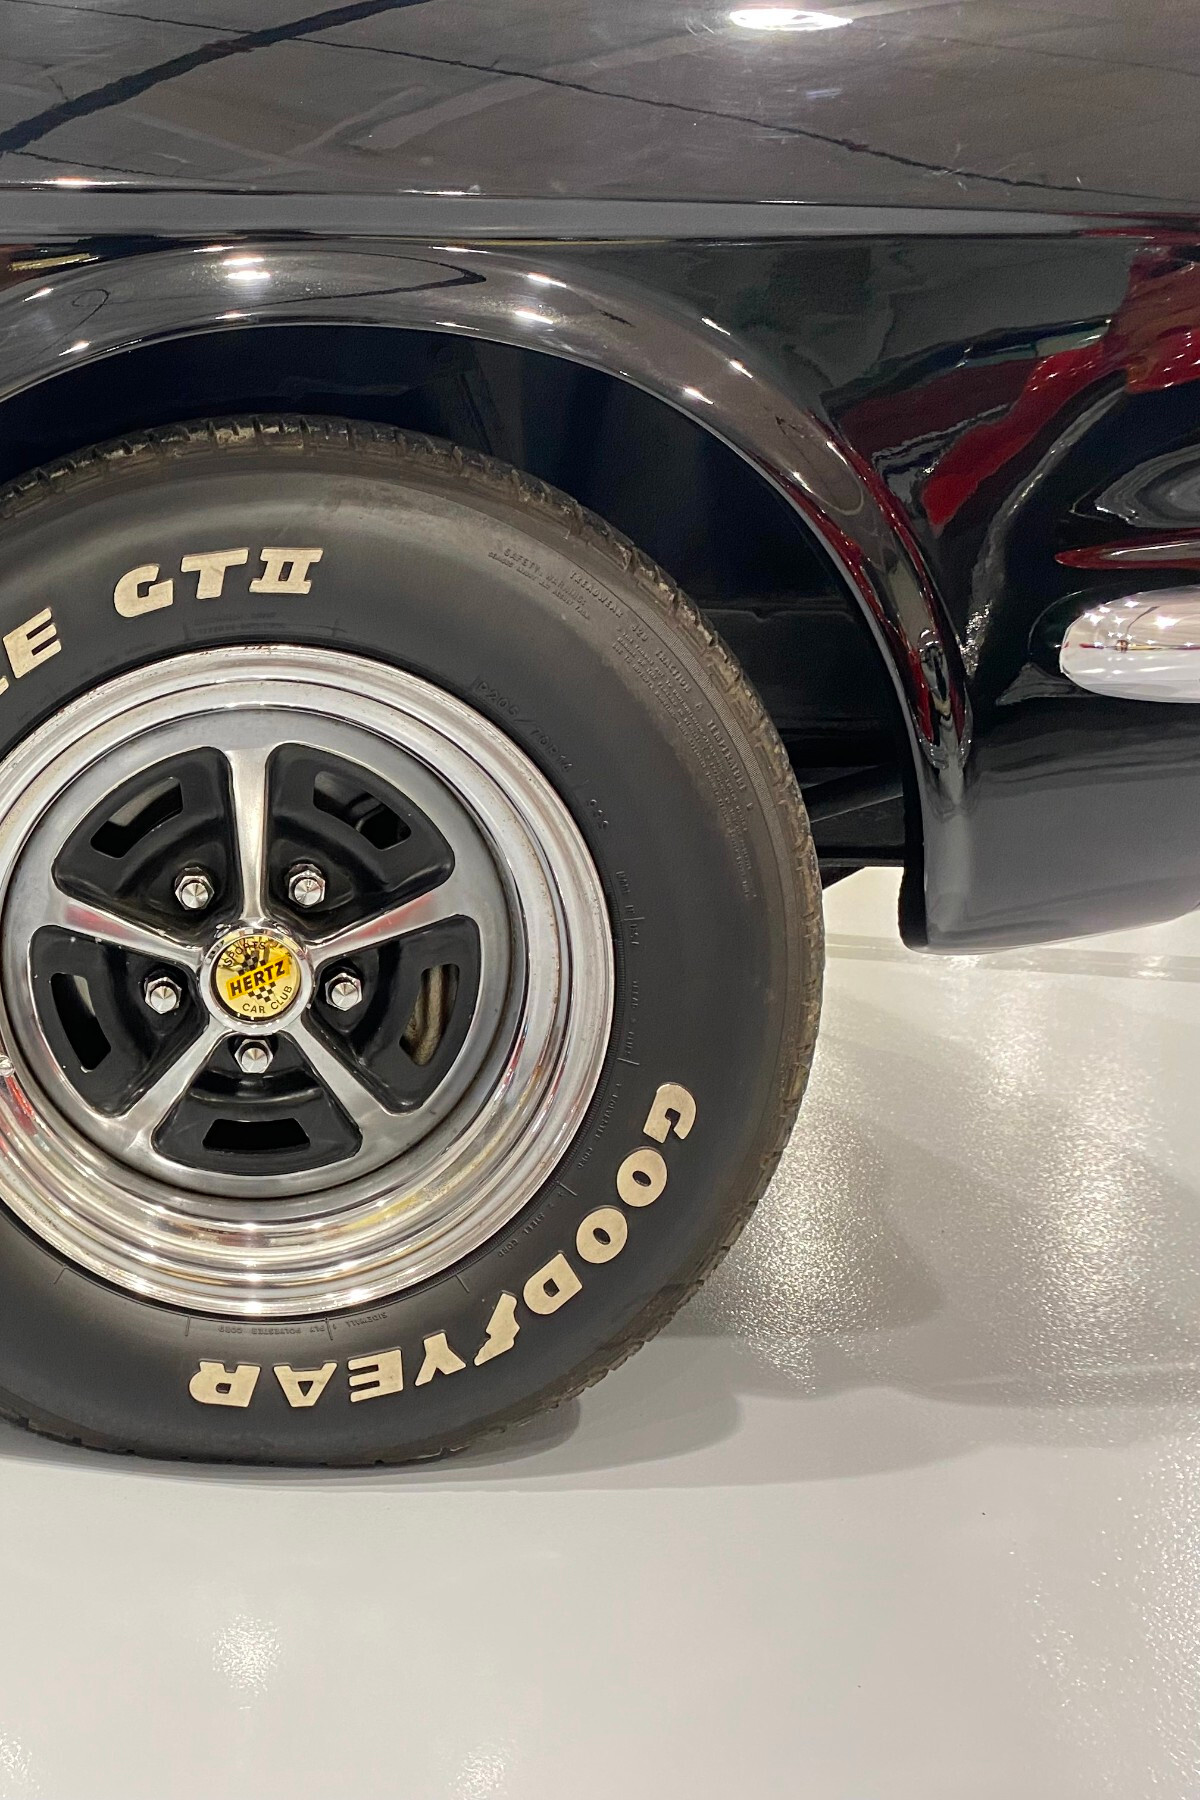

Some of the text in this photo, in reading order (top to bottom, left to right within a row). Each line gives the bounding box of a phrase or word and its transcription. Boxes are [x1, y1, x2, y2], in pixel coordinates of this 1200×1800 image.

[229, 959, 286, 997] HERTZ
[242, 985, 293, 1014] CAR CLUB
[188, 1081, 697, 1408] GOODYEAR
